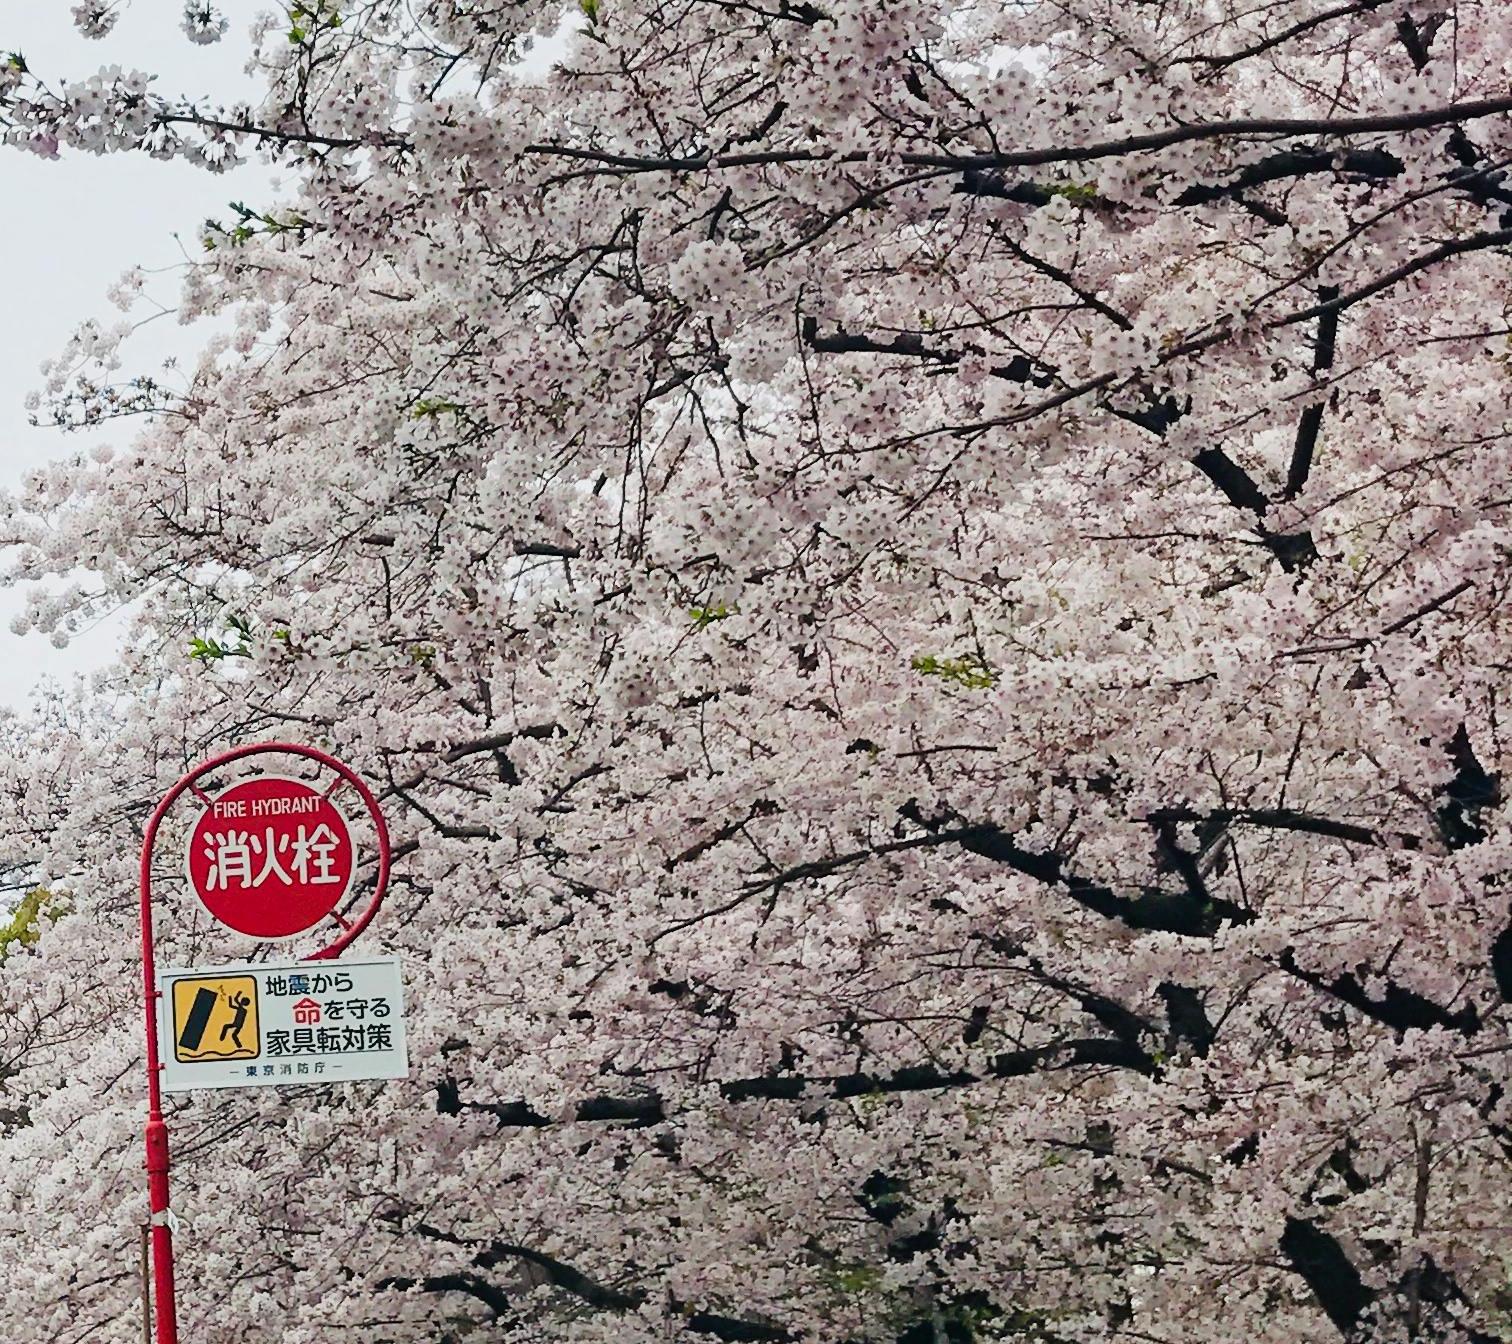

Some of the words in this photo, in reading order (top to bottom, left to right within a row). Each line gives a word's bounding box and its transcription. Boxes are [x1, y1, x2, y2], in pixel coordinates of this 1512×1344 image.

[213, 800, 247, 819] FIRE
[252, 795, 322, 816] HYDRANT
[203, 823, 341, 892] 消火栓
[265, 972, 354, 997] 地震から
[292, 997, 391, 1026] 命を守る
[266, 1022, 393, 1056] 家具転対策
